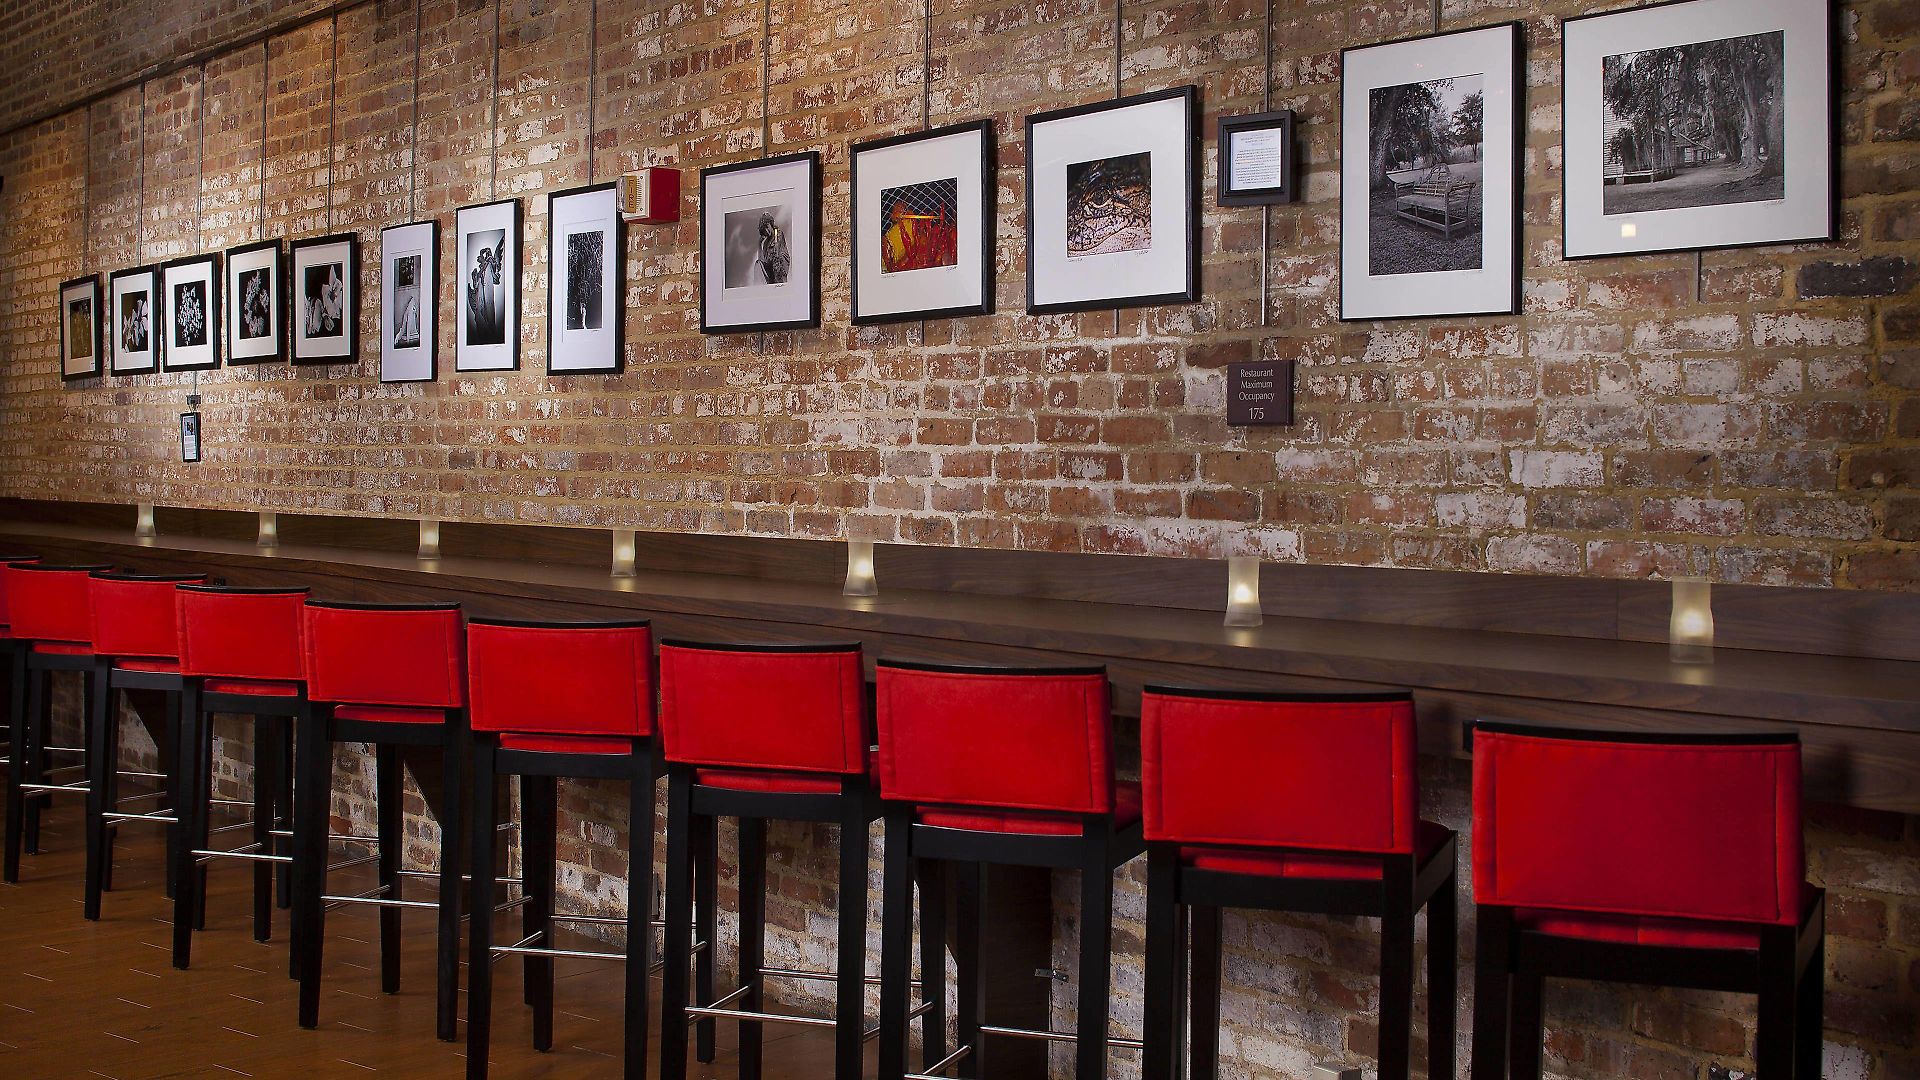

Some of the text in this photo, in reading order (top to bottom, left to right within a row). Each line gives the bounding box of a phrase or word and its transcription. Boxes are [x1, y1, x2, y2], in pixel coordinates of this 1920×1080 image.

[1240, 368, 1274, 378] Restaurant
[1240, 379, 1273, 389] Maximum
[1238, 391, 1275, 403] Occupancy
[1248, 407, 1264, 420] 175
